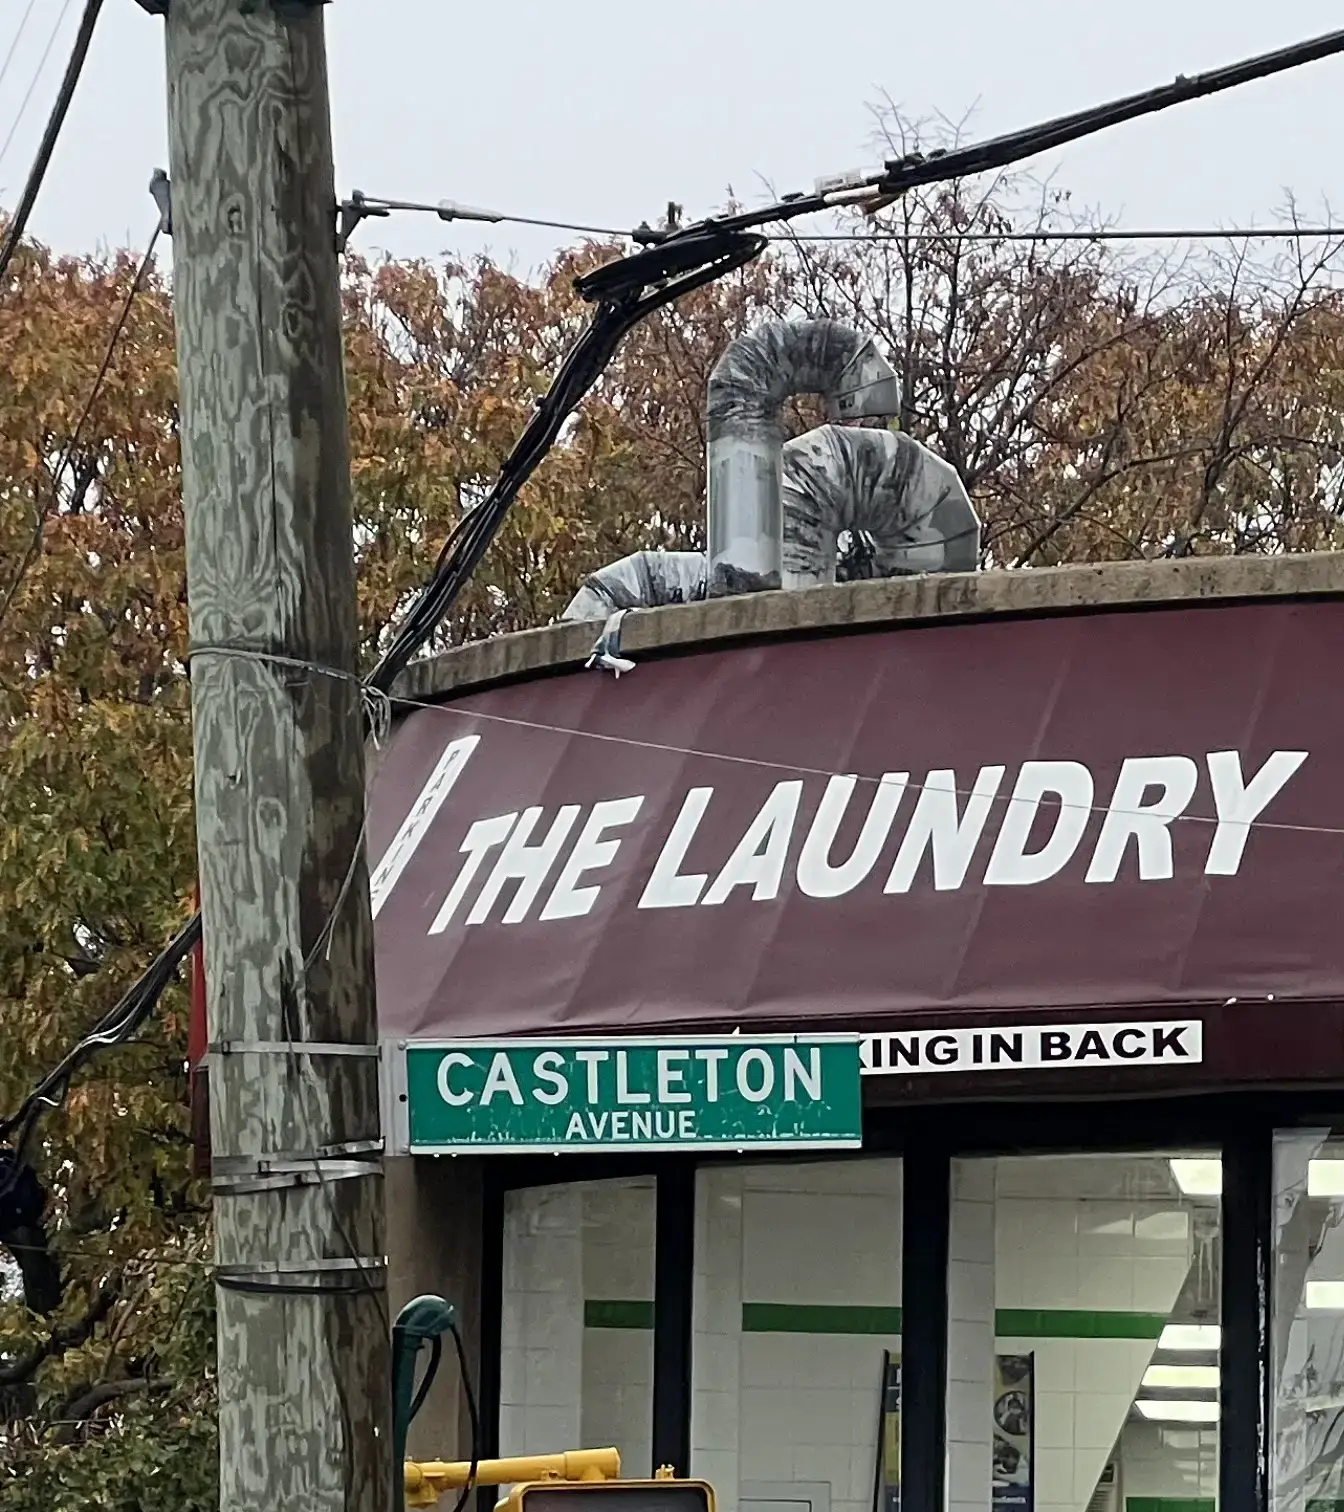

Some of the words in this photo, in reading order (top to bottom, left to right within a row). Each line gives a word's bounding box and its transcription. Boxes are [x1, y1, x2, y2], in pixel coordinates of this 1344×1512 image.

[428, 795, 646, 936] THE
[637, 750, 1309, 910] LAUNDRY
[858, 1035, 959, 1068] ING
[973, 1033, 1023, 1063] IN
[1040, 1027, 1190, 1061] BACK
[437, 1047, 823, 1108] CASTLETON
[565, 1110, 696, 1140] AVENUE
